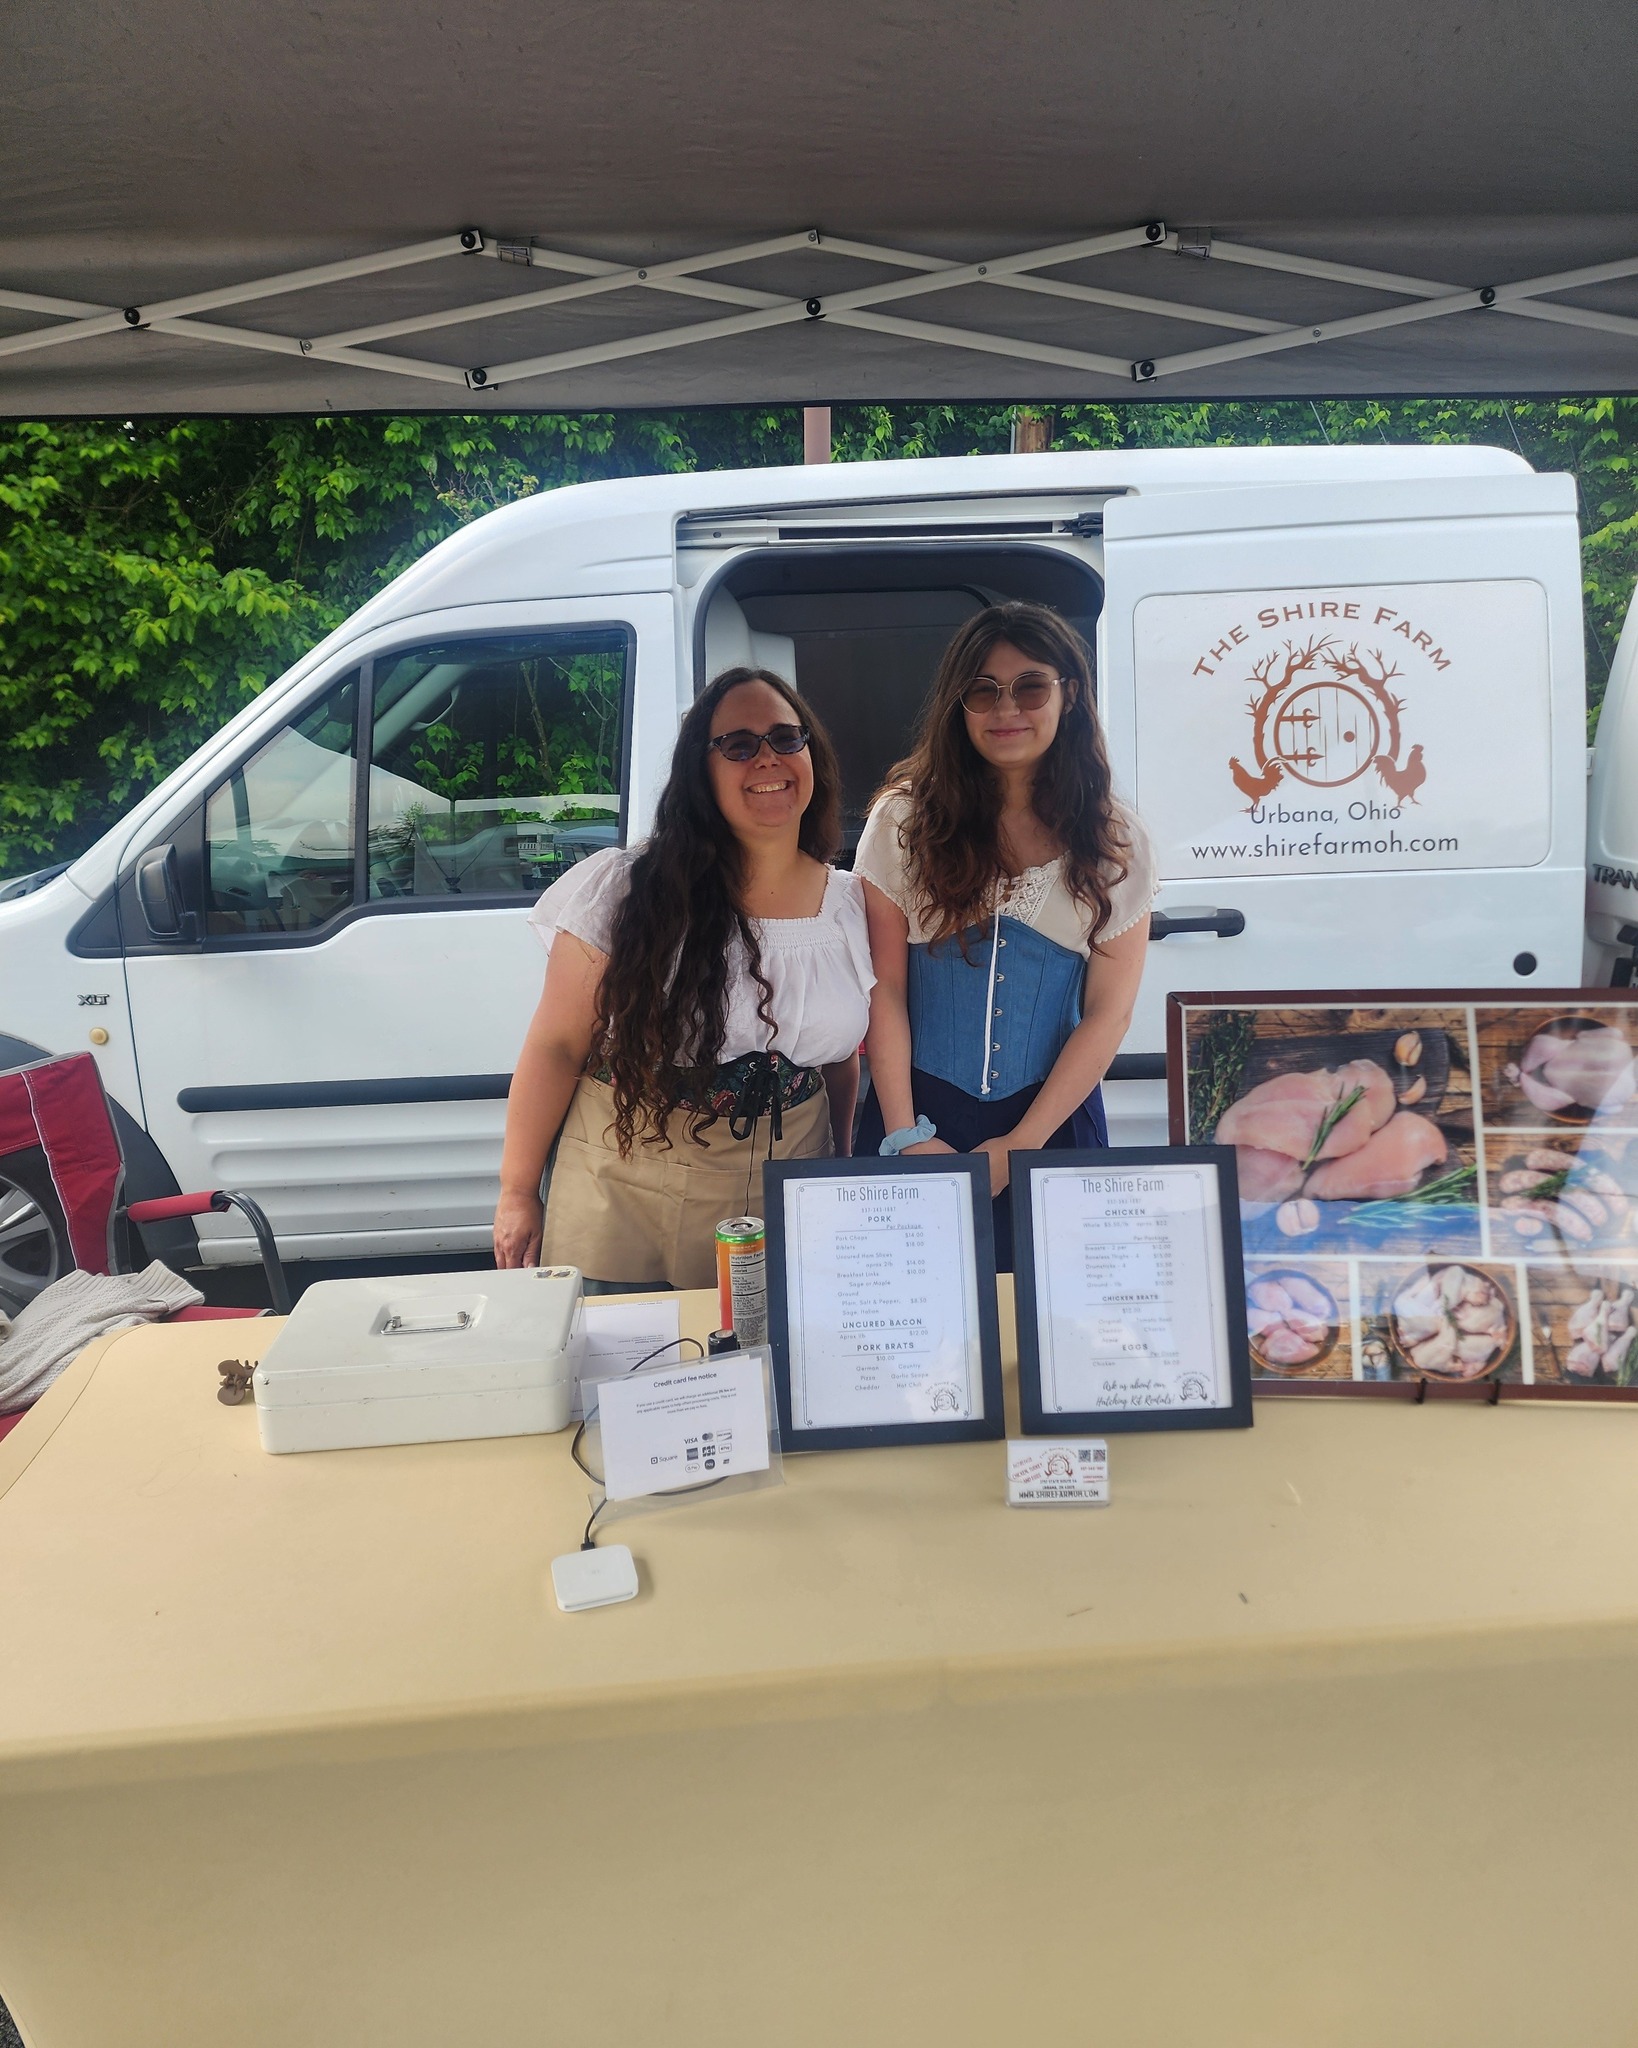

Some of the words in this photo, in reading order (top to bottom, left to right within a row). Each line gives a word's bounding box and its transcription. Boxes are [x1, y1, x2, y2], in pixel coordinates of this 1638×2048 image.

[1250, 804, 1340, 826] Urbana,
[1348, 800, 1401, 821] Ohio
[1192, 831, 1459, 860] www.shirefarmoh.com
[77, 993, 110, 1006] XLT
[1081, 1178, 1101, 1193] The
[1105, 1178, 1134, 1193] Shire
[1137, 1178, 1164, 1192] Farm
[837, 1187, 856, 1202] The
[860, 1186, 889, 1201] Shire
[892, 1186, 919, 1200] Farm
[868, 1215, 892, 1223] PORK
[843, 1320, 886, 1329] UNCURED
[890, 1318, 922, 1327] BACON
[857, 1344, 881, 1352] PORK
[886, 1342, 914, 1350] BRATS
[1122, 1343, 1149, 1351] EGGS
[654, 1380, 672, 1388] Credit
[673, 1377, 687, 1385] card
[699, 1372, 717, 1380] notice
[1096, 1393, 1127, 1409] Hatching
[1131, 1395, 1141, 1406] Kit
[659, 1455, 678, 1463] Square
